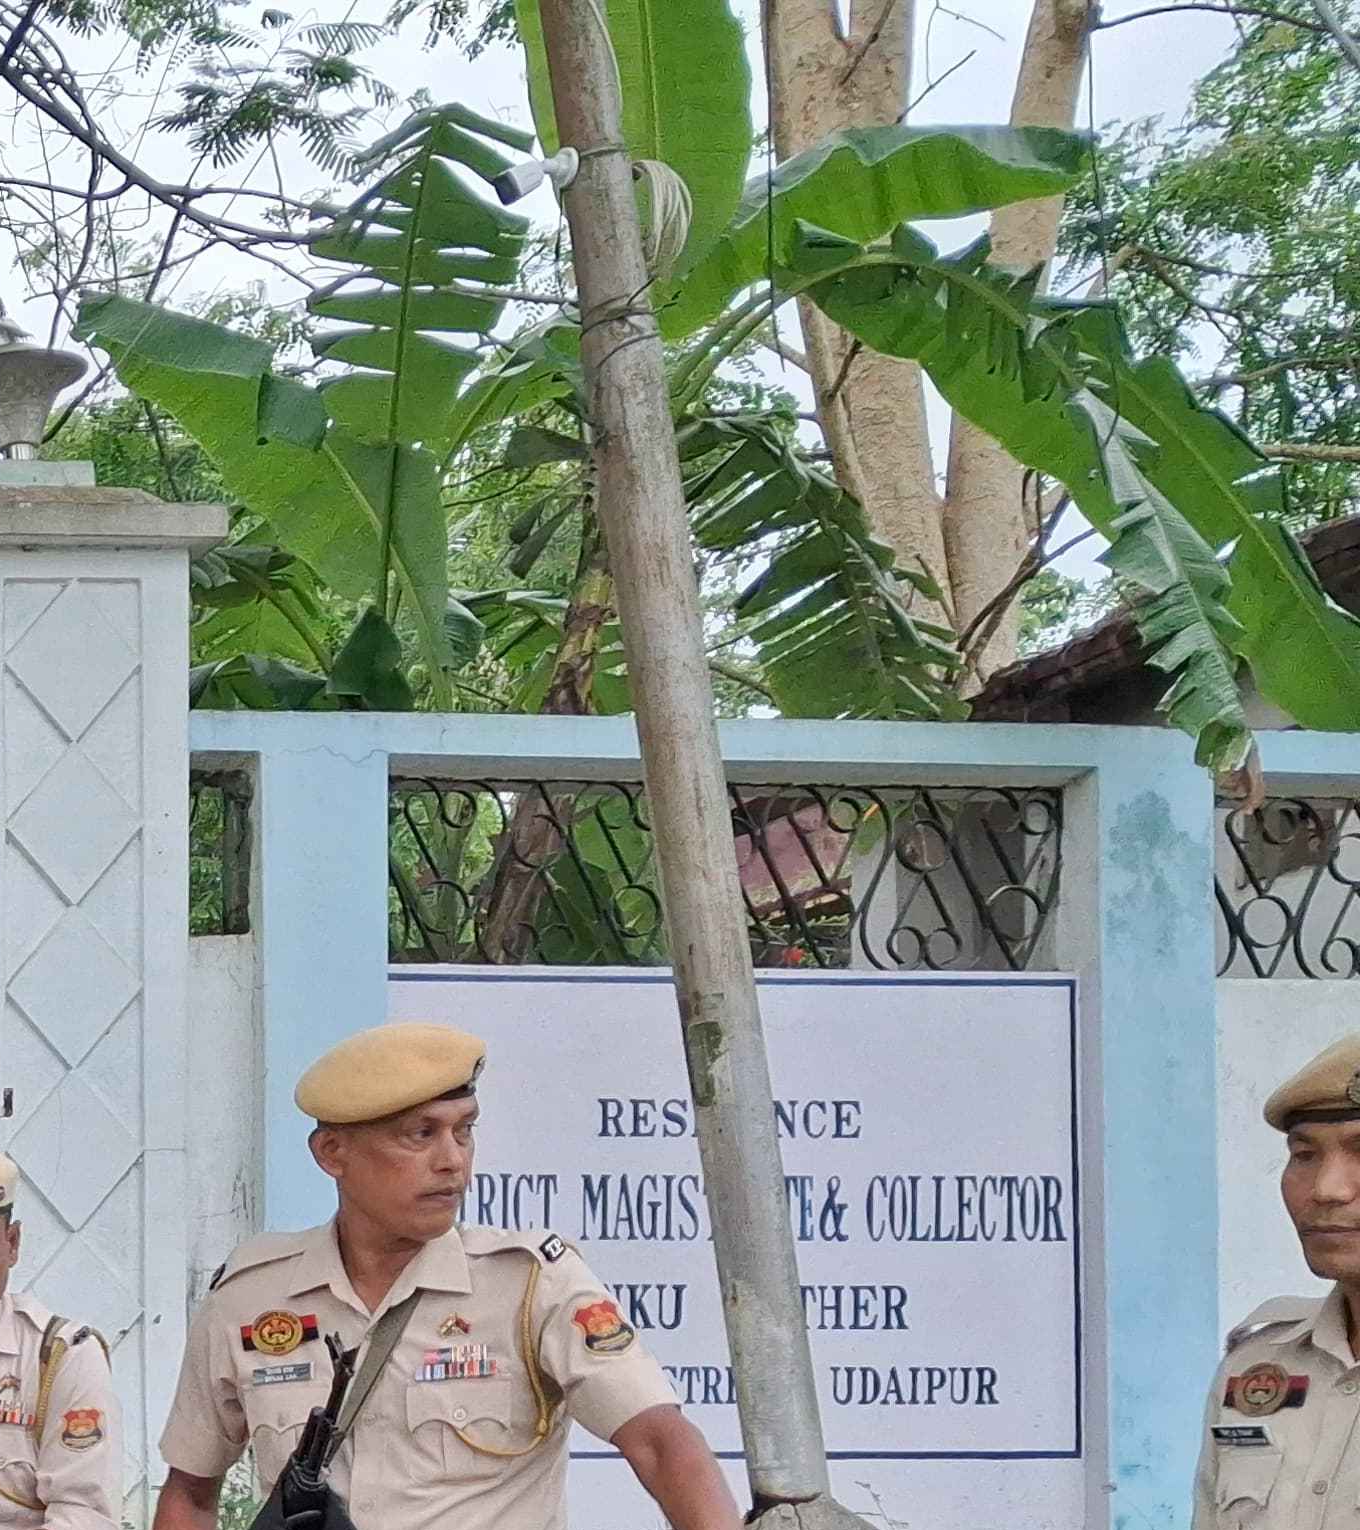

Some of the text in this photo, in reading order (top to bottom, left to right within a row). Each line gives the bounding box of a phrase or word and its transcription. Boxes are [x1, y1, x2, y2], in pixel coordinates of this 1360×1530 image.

[597, 1098, 862, 1138] RESNCE
[819, 1175, 849, 1242] &
[865, 1175, 1068, 1242] COLLECTOR
[799, 1285, 910, 1330] THER
[830, 1366, 1000, 1405] UDAIPUR
